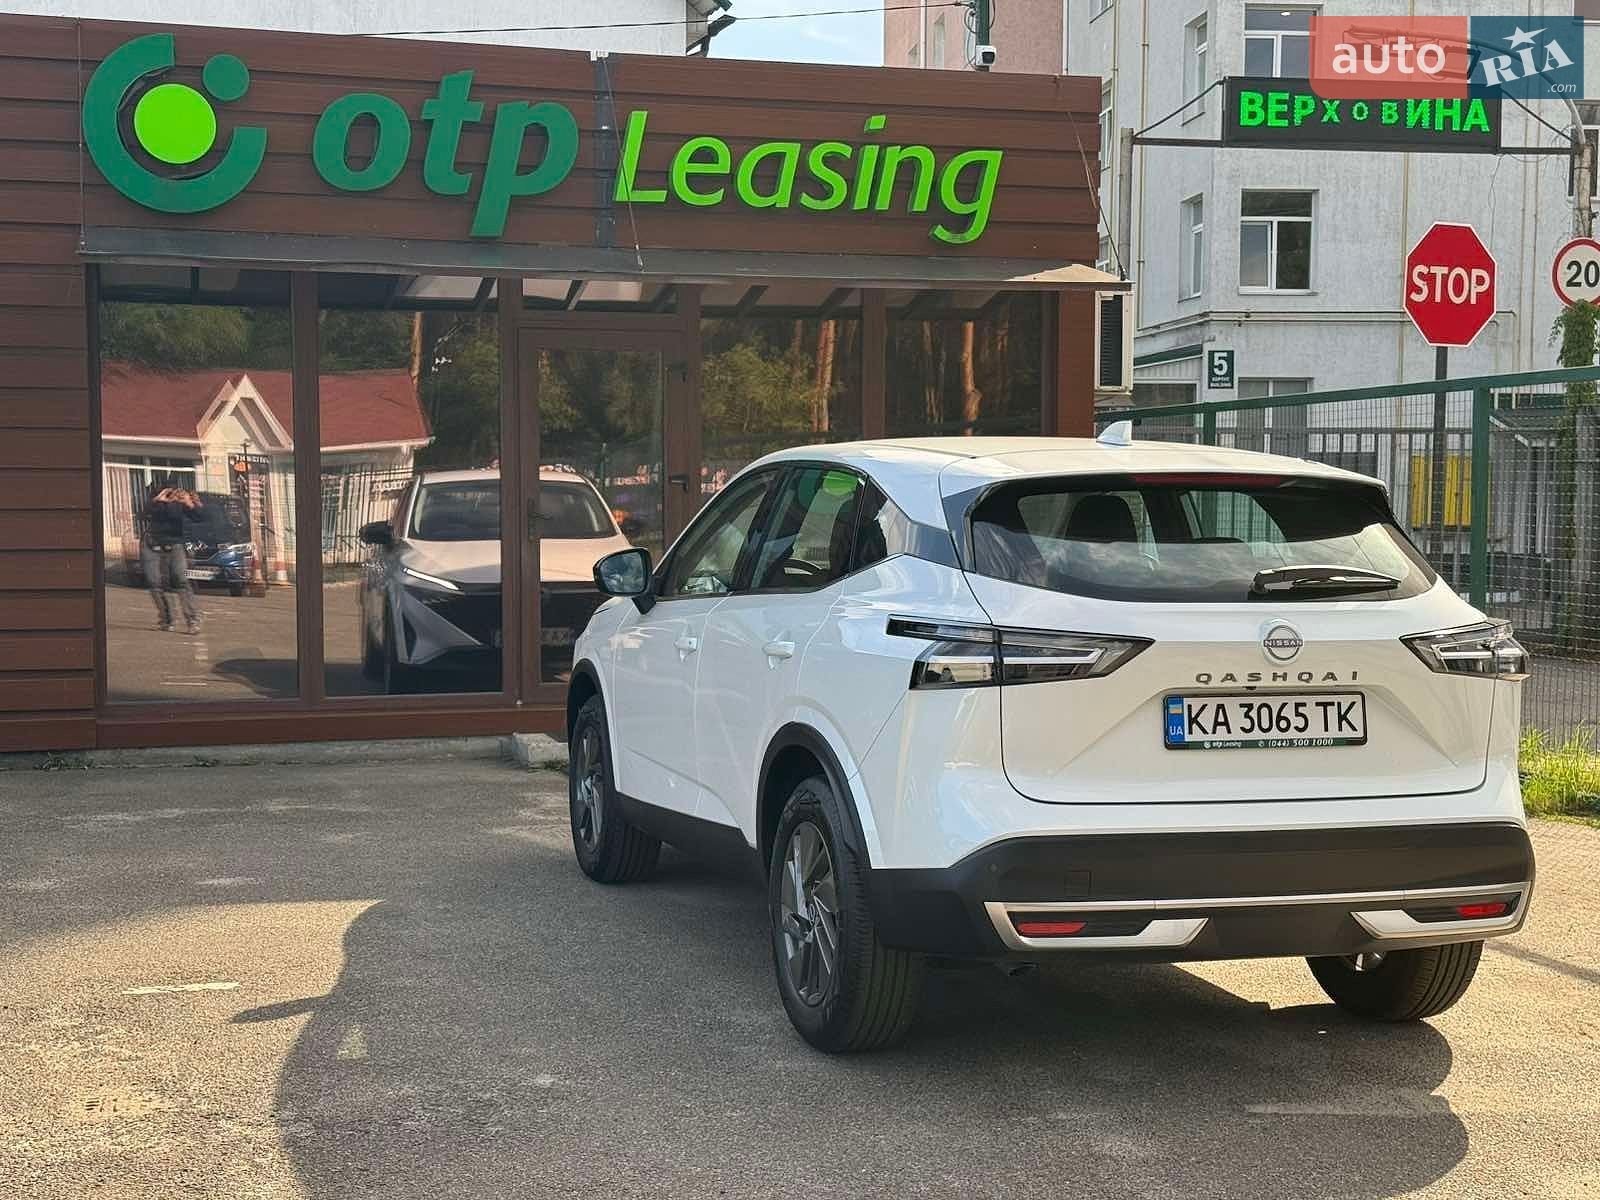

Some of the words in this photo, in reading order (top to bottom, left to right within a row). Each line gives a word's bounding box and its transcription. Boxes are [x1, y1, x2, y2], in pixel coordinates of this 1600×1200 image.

[312, 69, 579, 238] otp
[615, 110, 1004, 244] Leasing
[1408, 264, 1491, 305] STOP
[1565, 259, 1600, 288] 20
[1213, 351, 1229, 376] 5
[1263, 639, 1304, 648] NISSAN
[1195, 671, 1359, 684] QASHQAI
[1187, 702, 1232, 735] KA
[1239, 701, 1310, 734] 3065
[1315, 700, 1359, 733] TK
[1169, 725, 1184, 736] UA
[1268, 739, 1290, 748] (044)
[1293, 738, 1309, 747] 500
[1312, 738, 1334, 746] 1000
